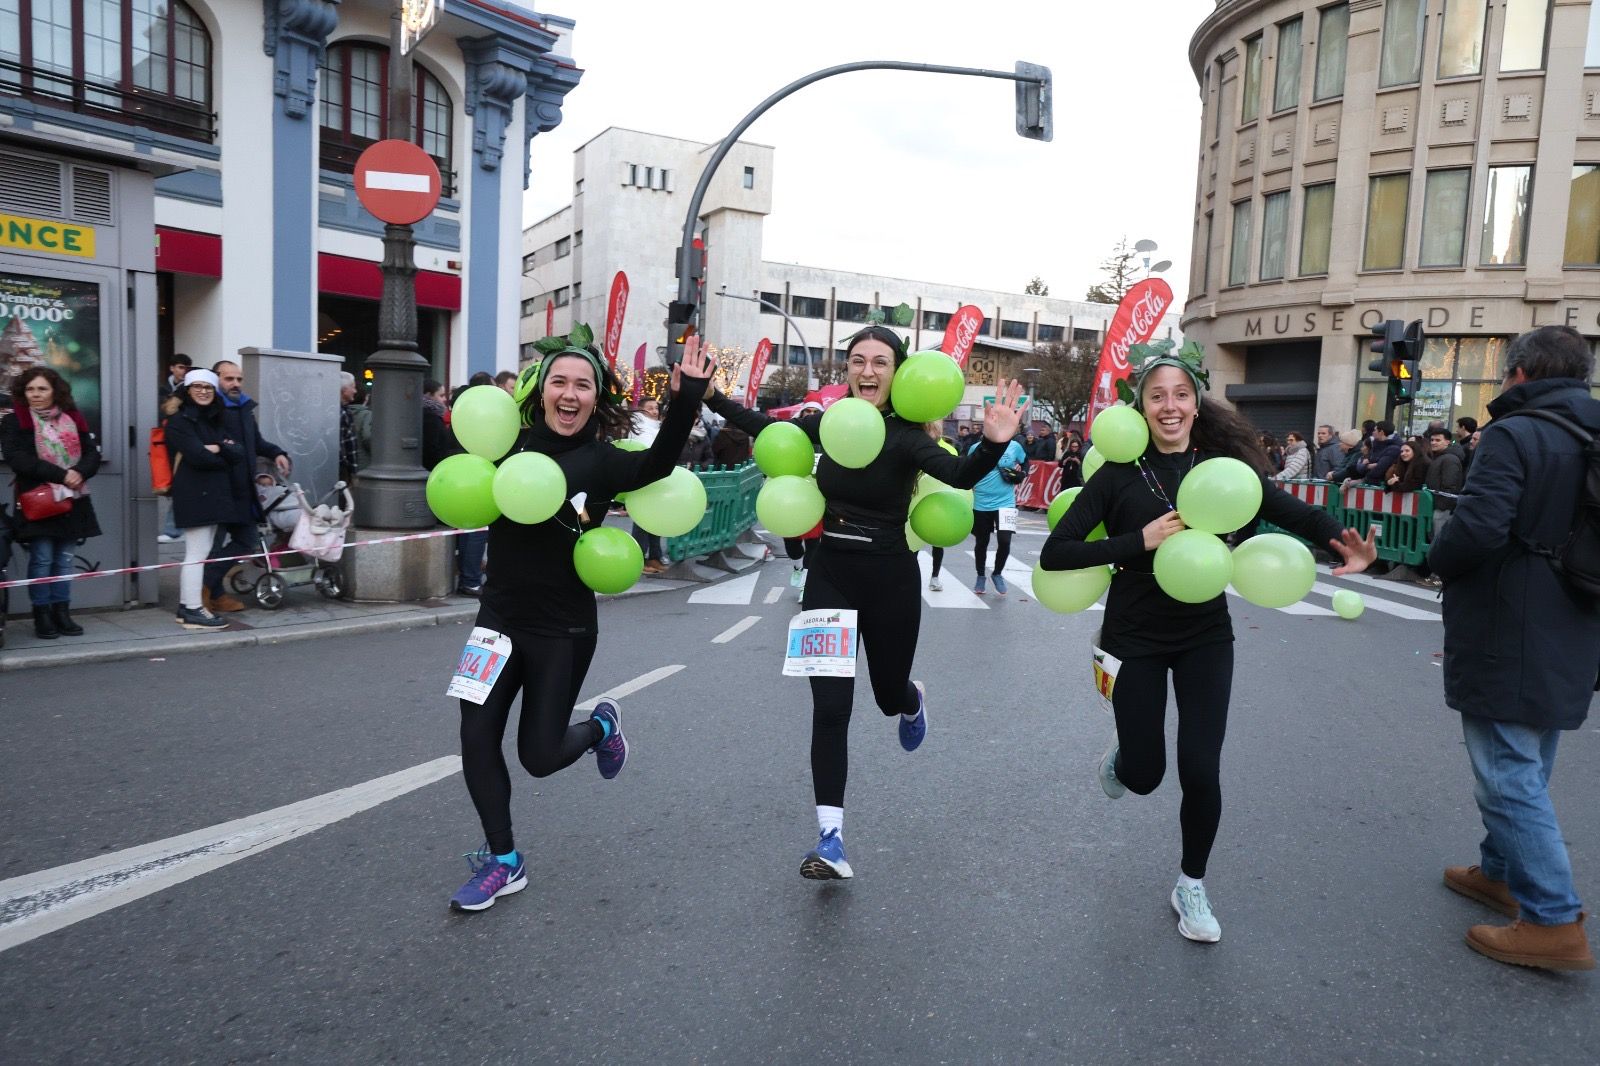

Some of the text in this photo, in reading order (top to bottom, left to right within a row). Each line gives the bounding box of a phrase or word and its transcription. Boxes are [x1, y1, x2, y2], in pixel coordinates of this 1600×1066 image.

[0, 221, 82, 251] NCE
[1244, 306, 1600, 337] MUSEO DE LE
[801, 633, 836, 656] 1536
